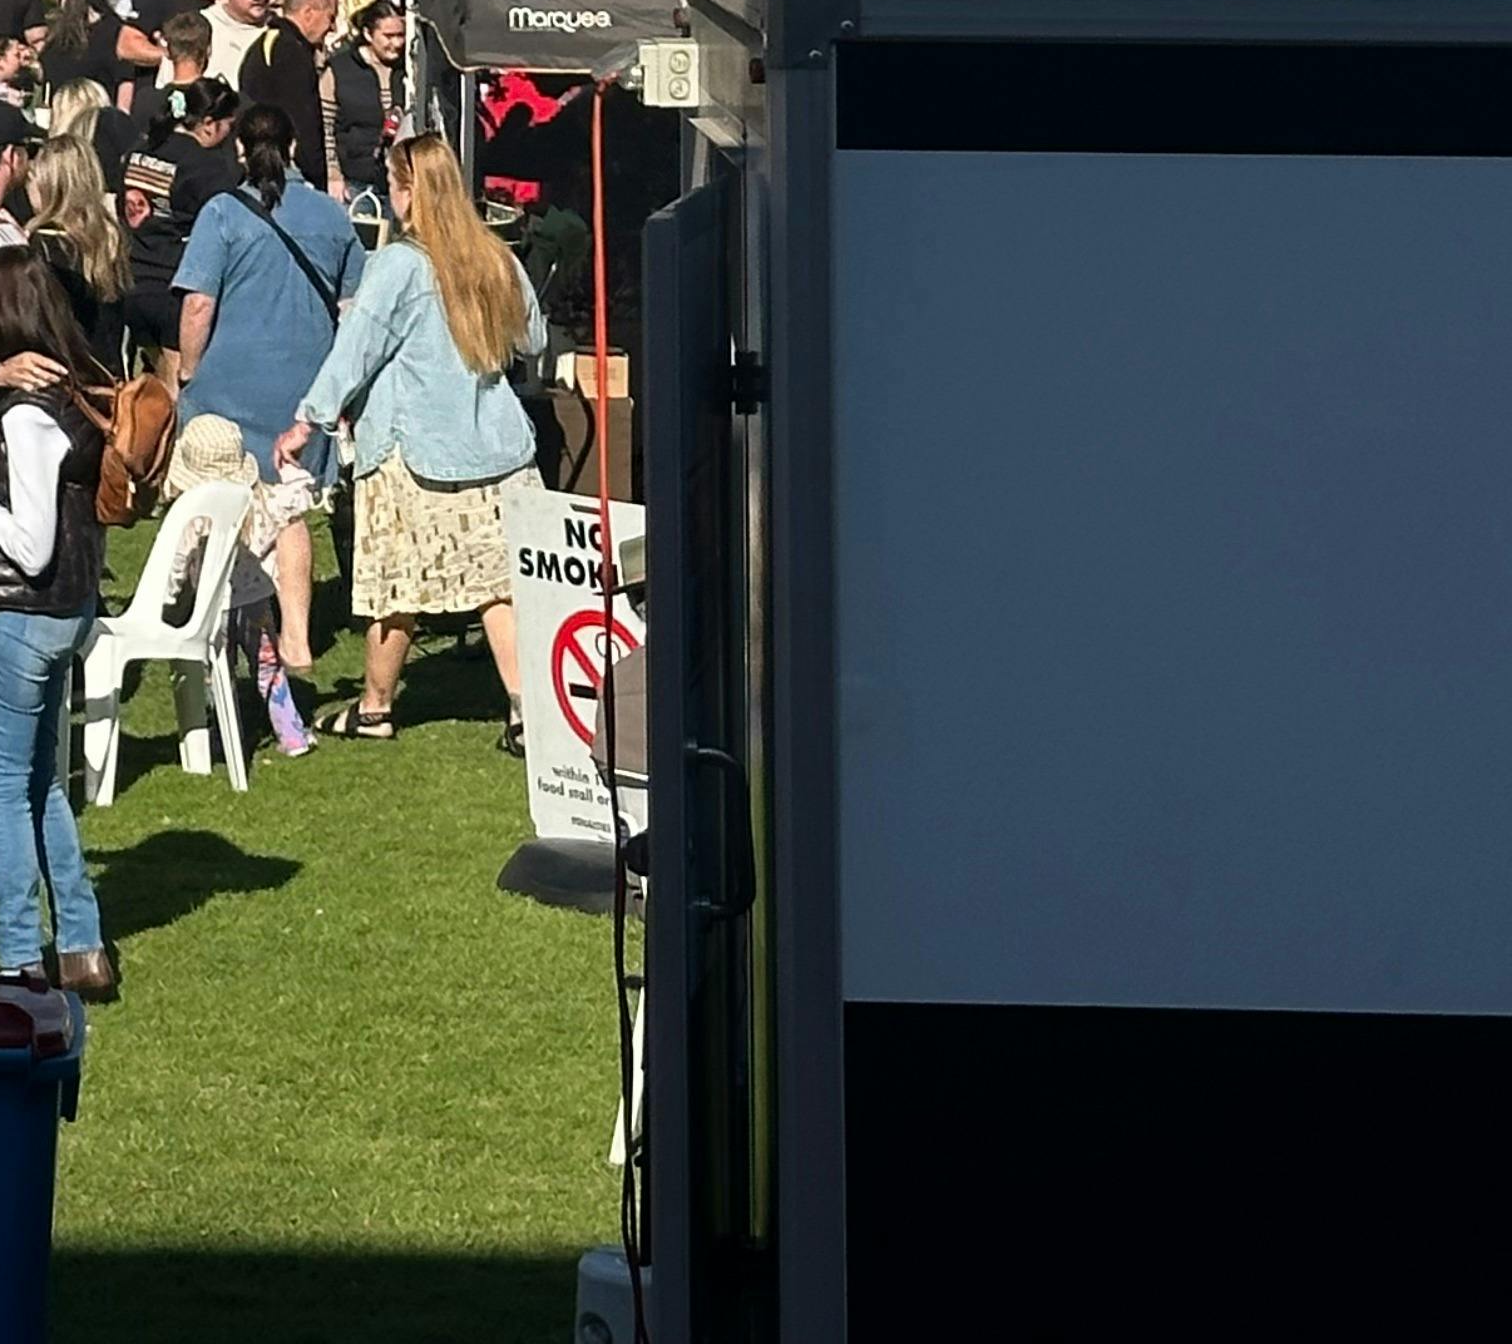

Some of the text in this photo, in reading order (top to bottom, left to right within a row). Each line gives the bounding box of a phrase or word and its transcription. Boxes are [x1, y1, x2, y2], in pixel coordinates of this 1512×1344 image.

[508, 6, 613, 34] Marquee
[551, 764, 590, 784] within
[537, 775, 565, 797] food
[568, 785, 594, 803] stall
